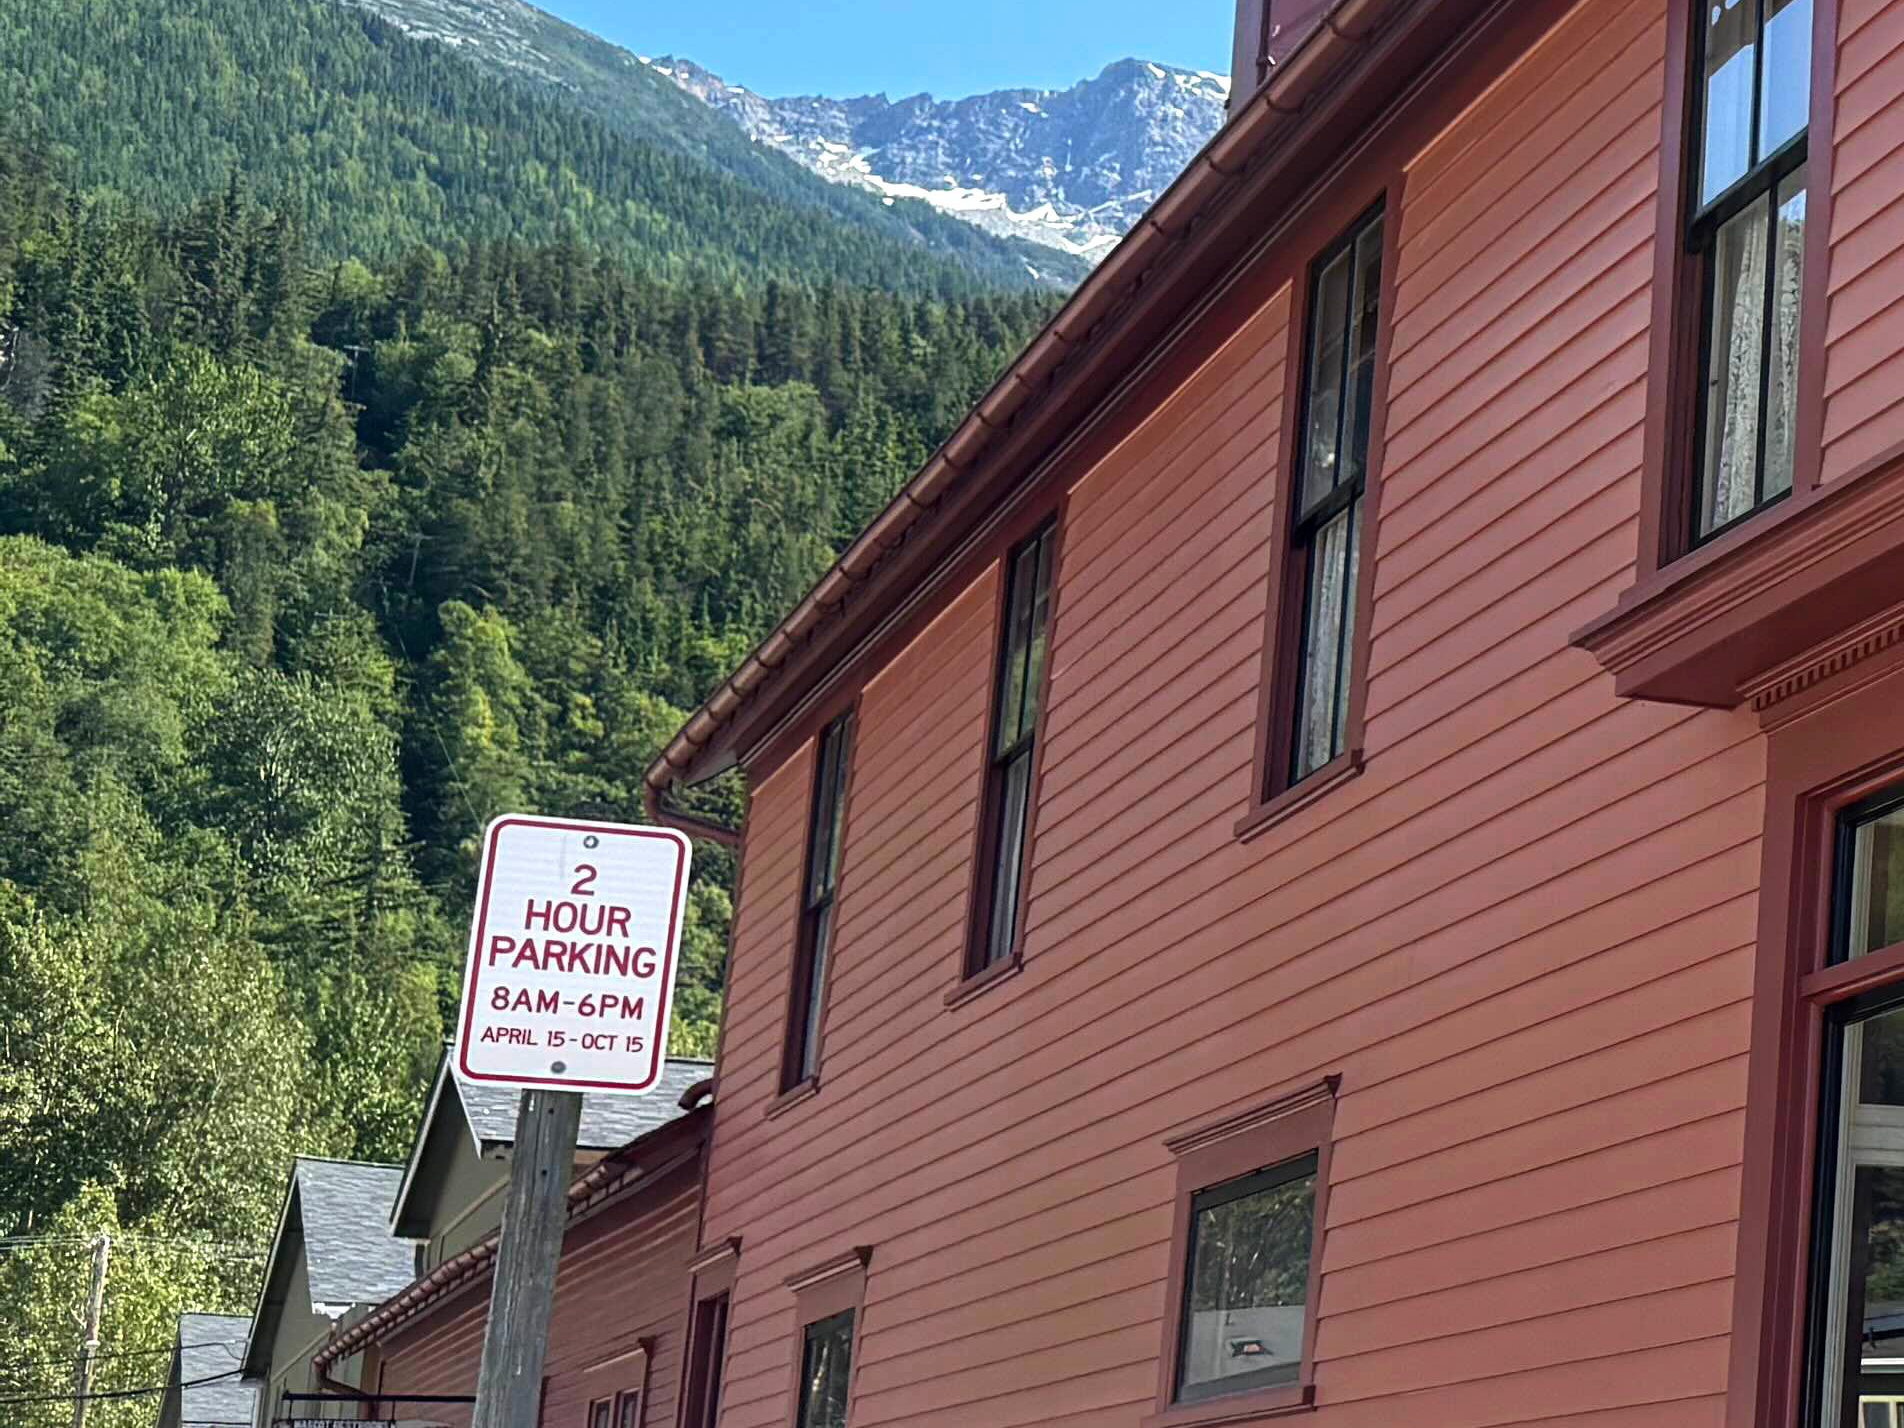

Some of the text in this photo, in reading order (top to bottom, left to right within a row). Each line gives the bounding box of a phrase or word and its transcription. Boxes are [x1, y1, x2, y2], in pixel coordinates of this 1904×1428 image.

[571, 864, 597, 896] 2
[525, 899, 631, 938] HOUR
[489, 936, 656, 978] PARKING
[491, 986, 644, 1020] 8AM-6PM
[481, 1026, 538, 1045] APRIL
[626, 1036, 644, 1052] 15
[294, 1420, 330, 1428] MASCOT
